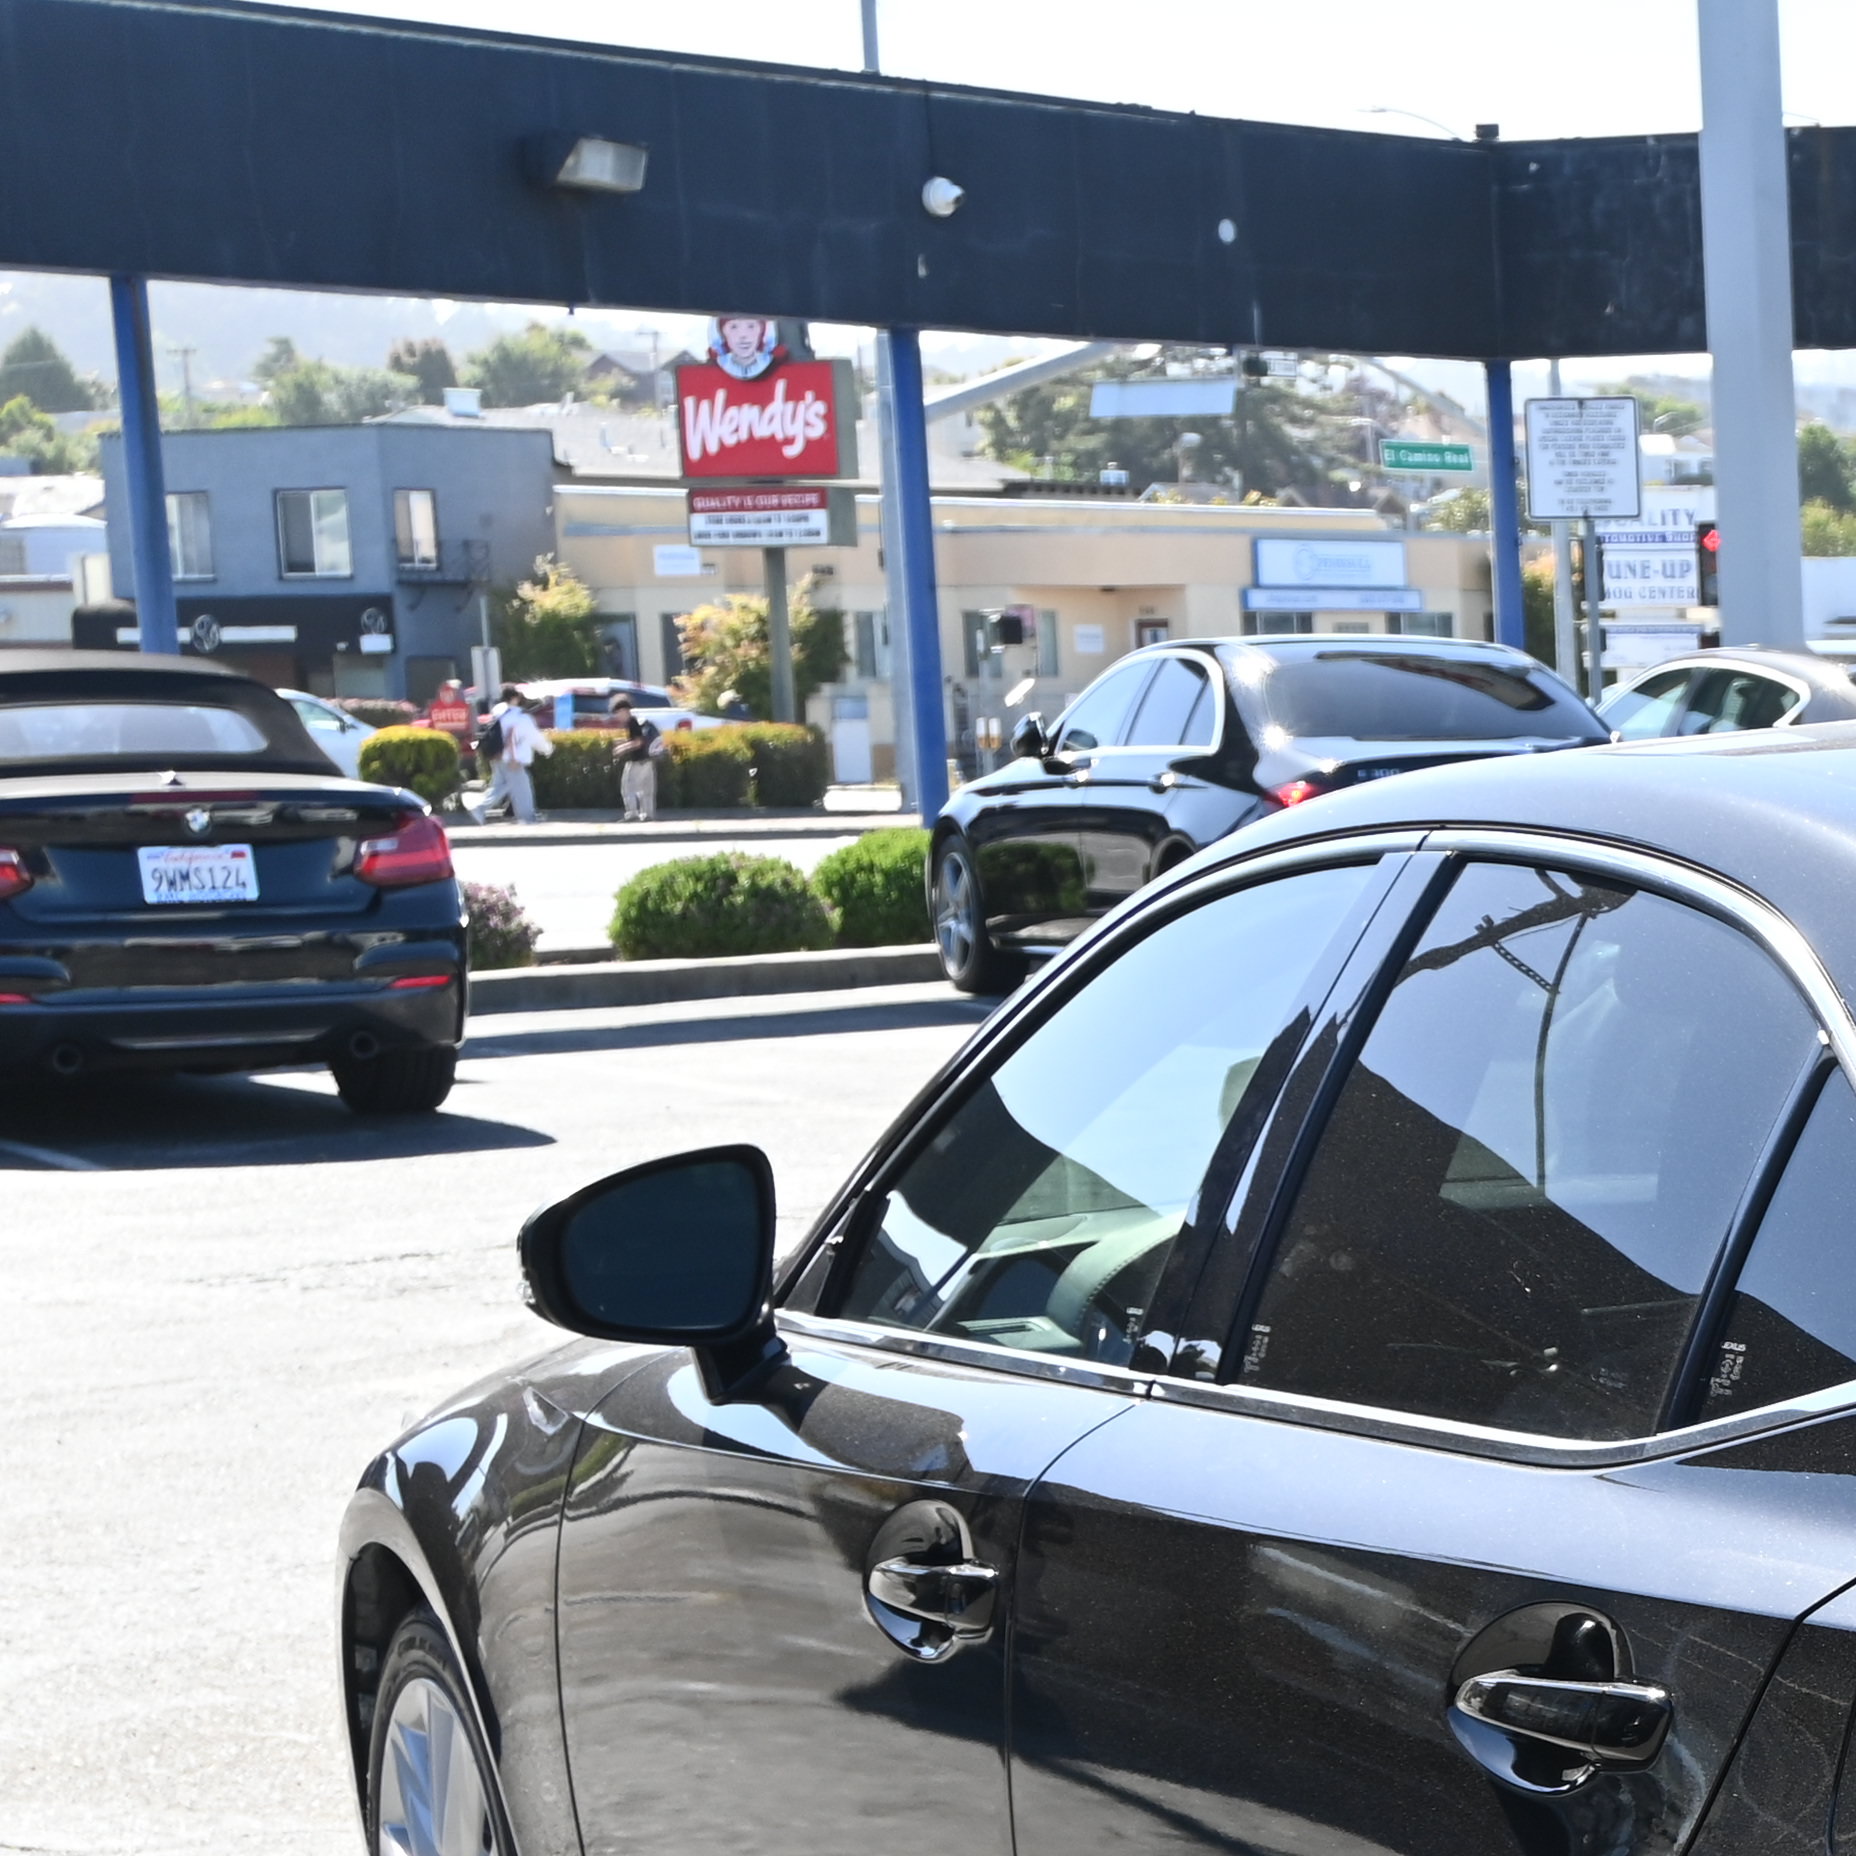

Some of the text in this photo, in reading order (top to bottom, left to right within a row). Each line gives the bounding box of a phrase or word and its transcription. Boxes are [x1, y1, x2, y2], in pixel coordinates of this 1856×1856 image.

[683, 377, 829, 463] Wendy's
[1384, 449, 1469, 464] El Camino Real
[692, 492, 819, 511] QUALITY IS OUR RECIPE
[1607, 559, 1692, 580] UNE-UP
[1638, 585, 1697, 600] CENTER
